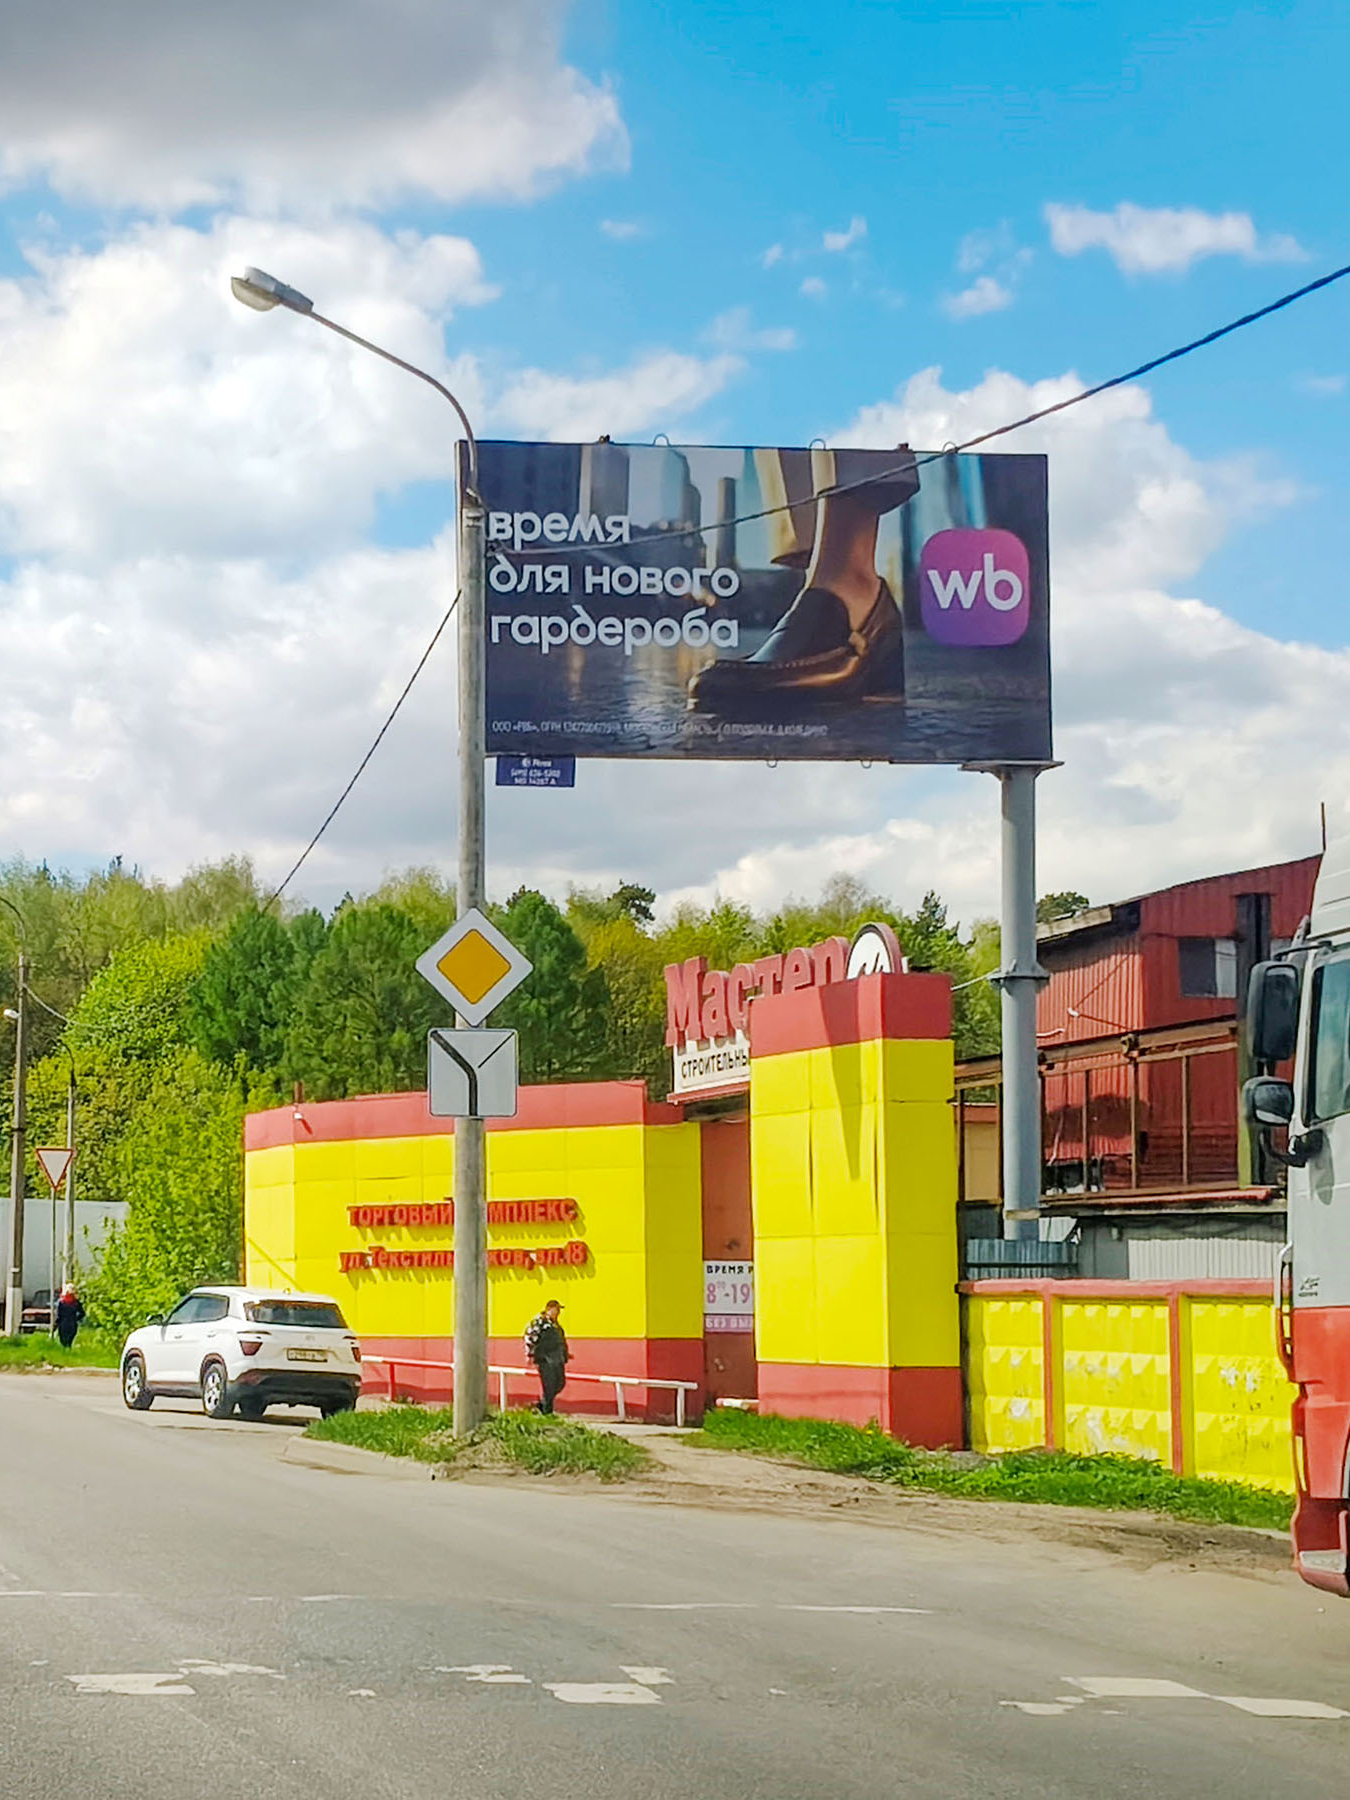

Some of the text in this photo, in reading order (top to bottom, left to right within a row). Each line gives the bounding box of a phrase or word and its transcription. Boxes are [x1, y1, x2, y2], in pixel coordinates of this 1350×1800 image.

[489, 512, 631, 549] время
[489, 553, 740, 597] для нового
[927, 552, 1023, 611] wb
[491, 604, 739, 656] гардероба
[487, 1198, 579, 1223] МПЛЕКС
